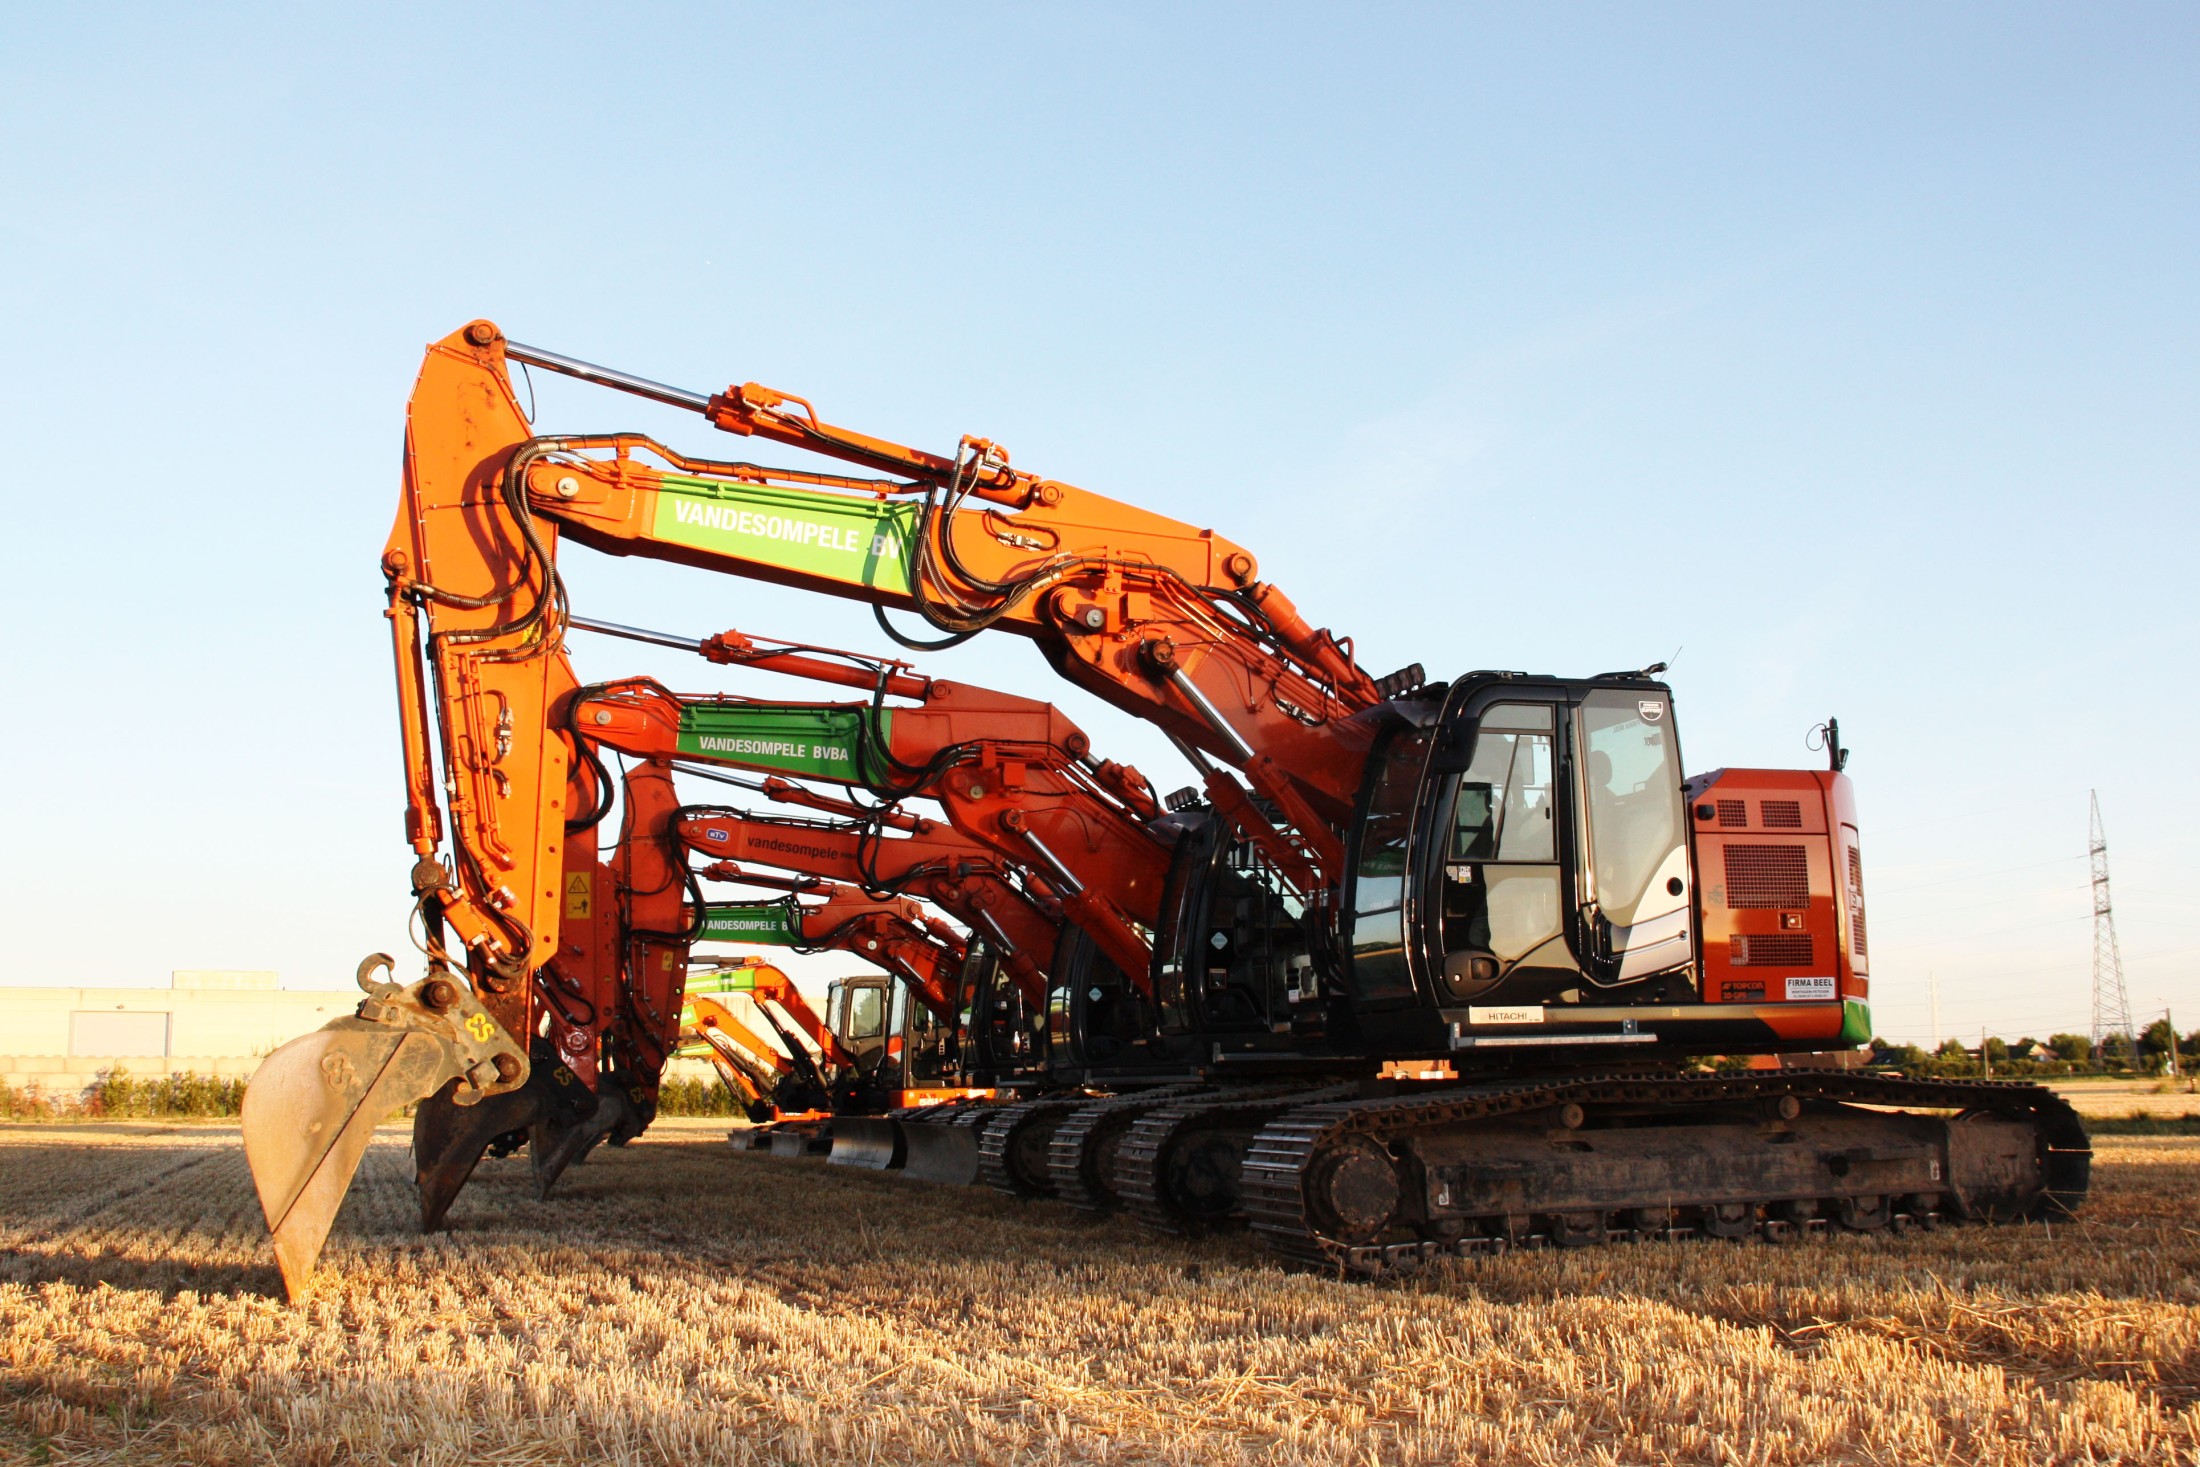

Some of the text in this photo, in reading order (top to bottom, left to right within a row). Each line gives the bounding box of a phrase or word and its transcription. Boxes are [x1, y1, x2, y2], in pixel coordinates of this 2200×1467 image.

[674, 500, 902, 559] VANDESOMPELE BV
[699, 736, 849, 761] VANDESOMPELE BVBA
[747, 836, 838, 860] vandesompele
[702, 920, 777, 931] ANDESOMPELE
[1787, 978, 1833, 987] FIRMA BEEL
[1488, 1012, 1527, 1021] HITACHI
